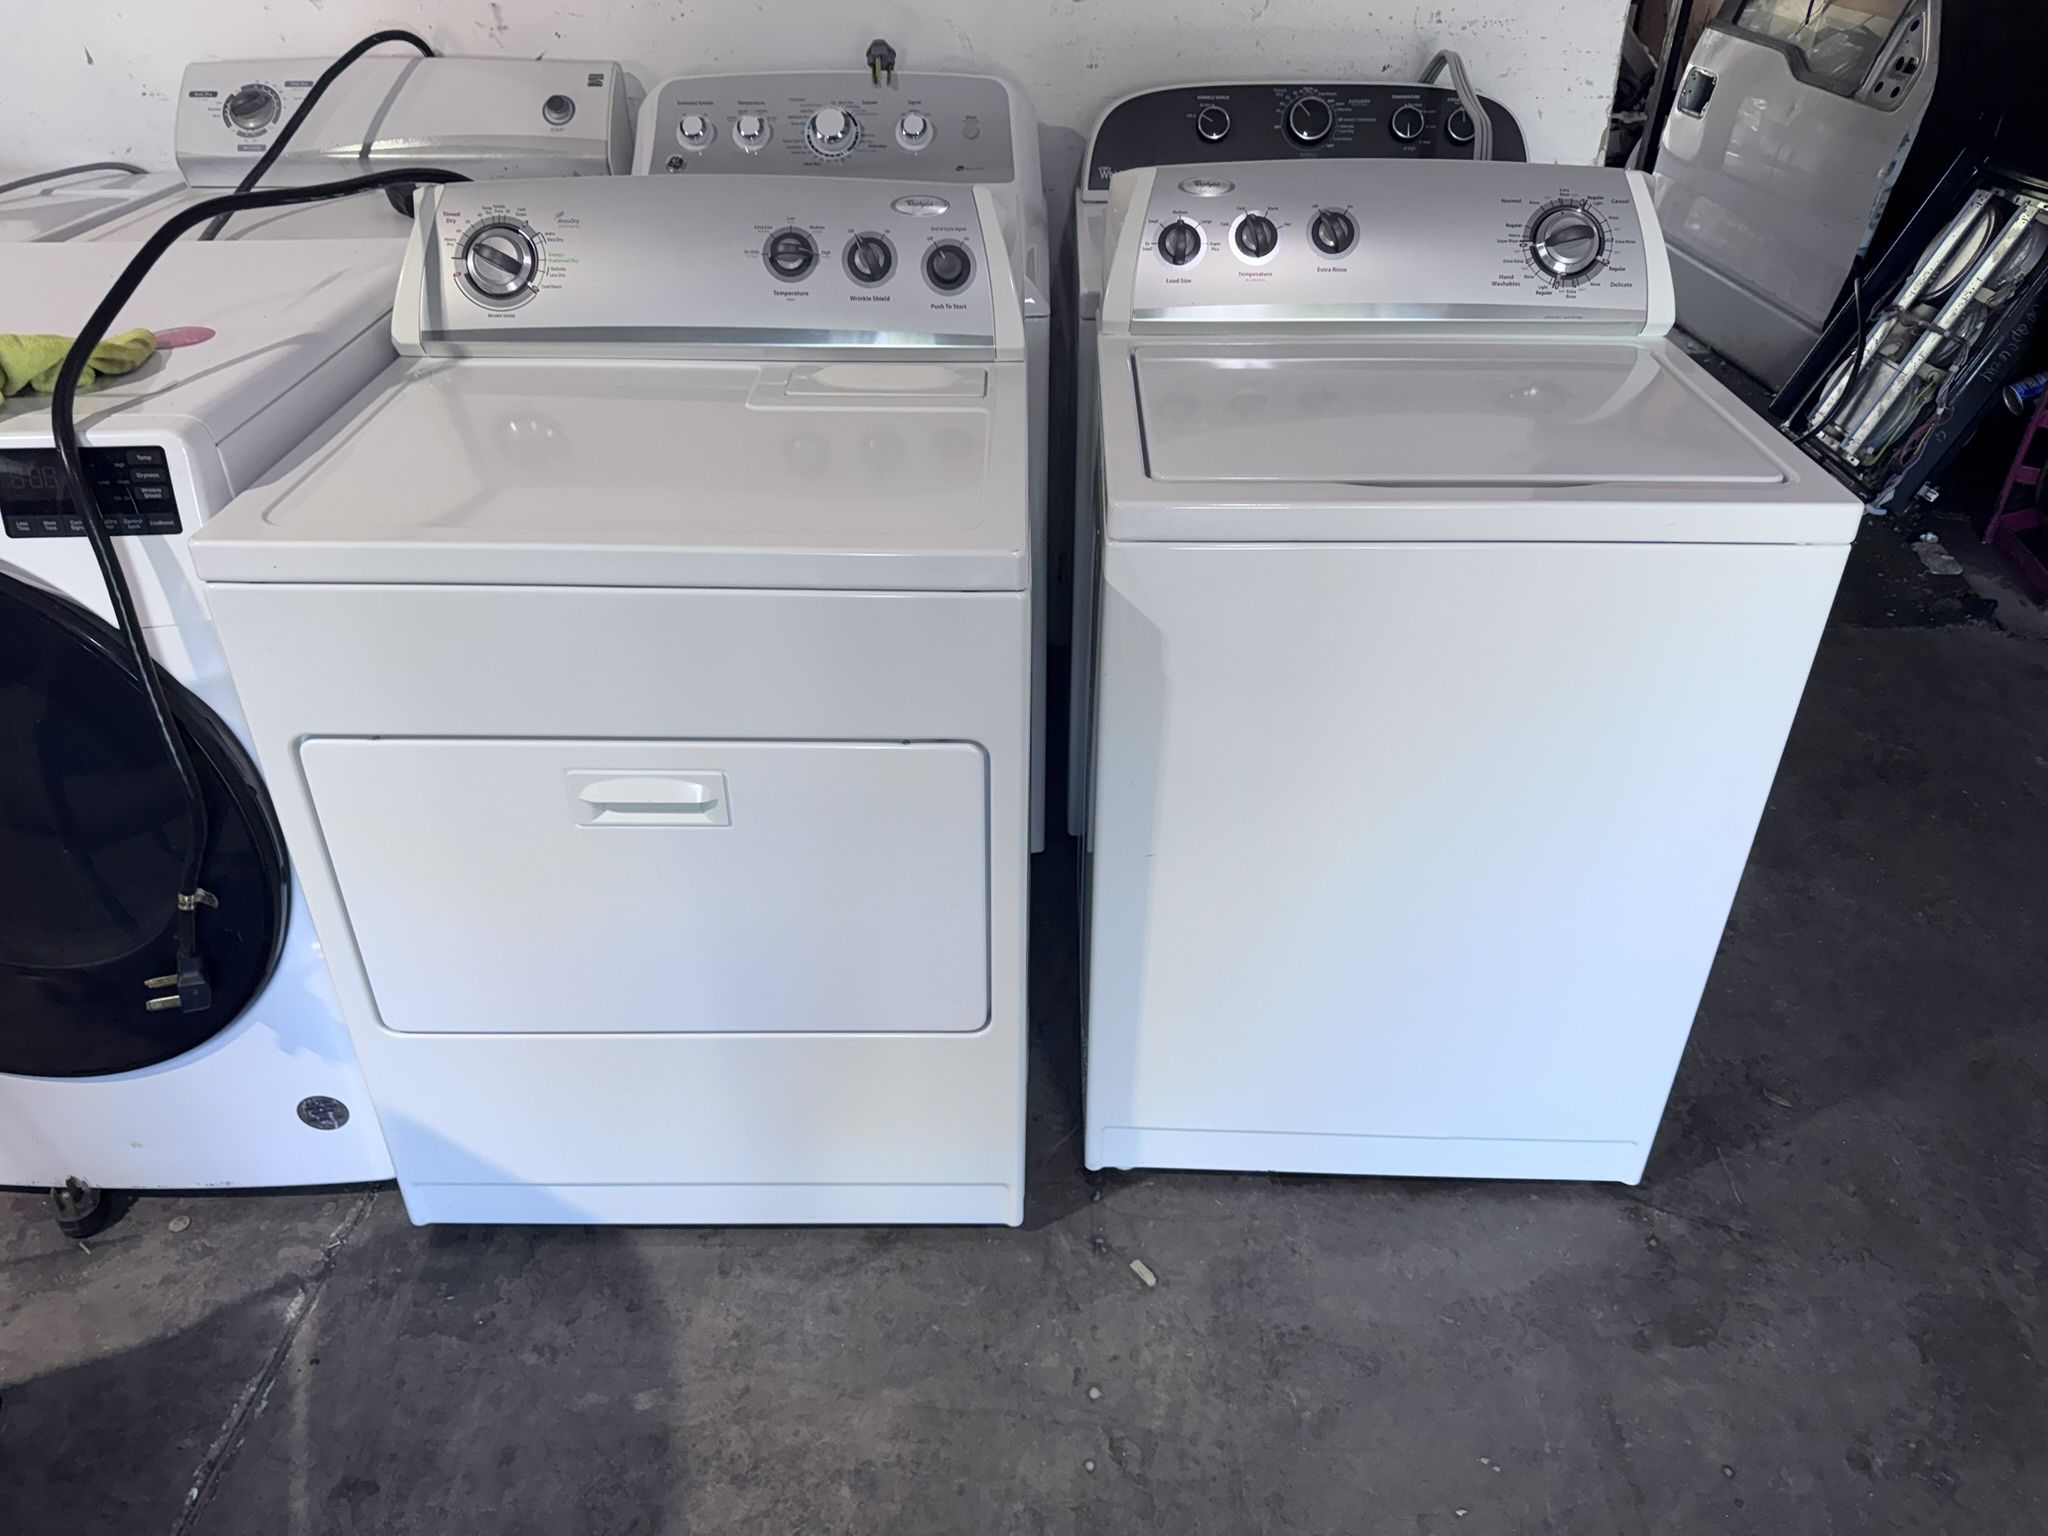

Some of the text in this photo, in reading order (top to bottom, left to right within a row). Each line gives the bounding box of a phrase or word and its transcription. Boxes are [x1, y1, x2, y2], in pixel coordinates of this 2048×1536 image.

[905, 200, 934, 208] Whirlpool
[773, 290, 809, 298] Temperature
[136, 454, 152, 462] Temp
